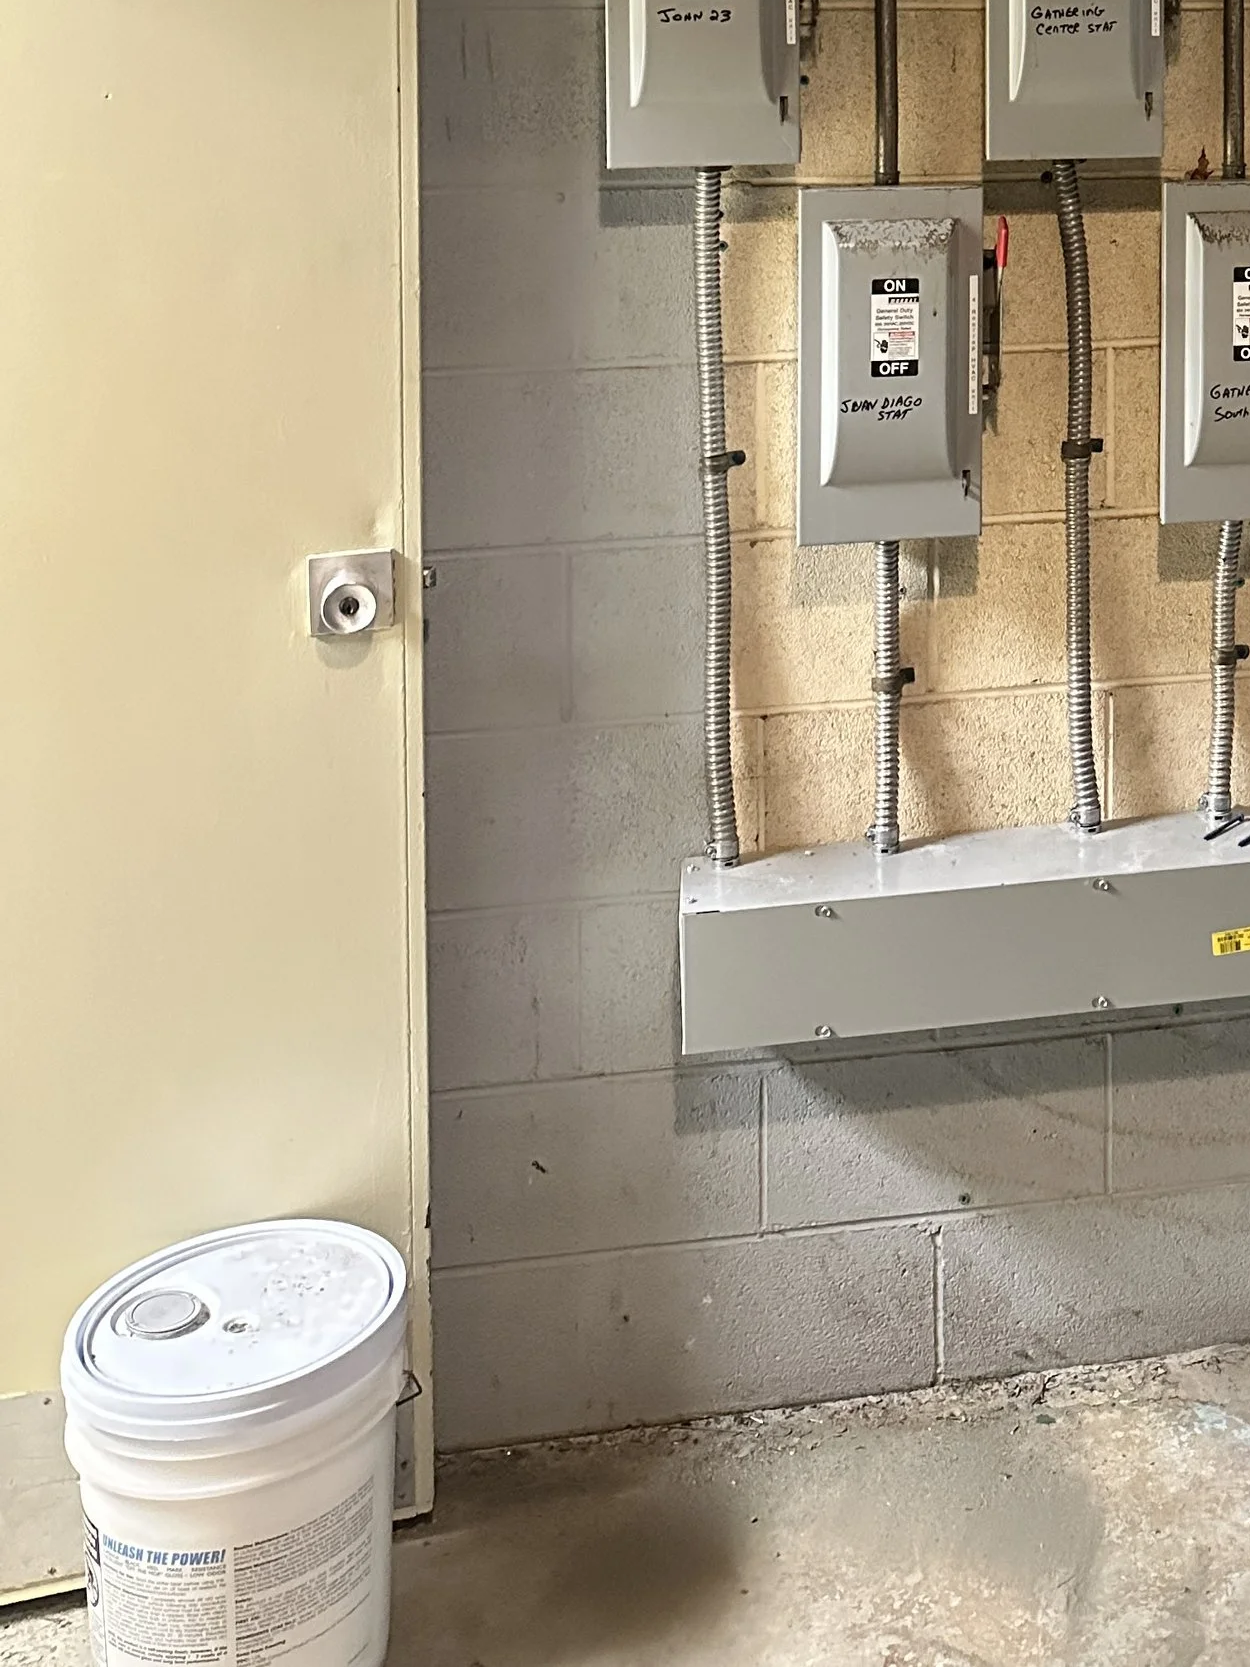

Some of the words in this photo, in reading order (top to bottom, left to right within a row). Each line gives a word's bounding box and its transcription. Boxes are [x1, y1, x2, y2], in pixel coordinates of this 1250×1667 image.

[657, 8, 703, 23] JOHN
[709, 9, 731, 22] 23
[884, 279, 907, 292] ON
[878, 362, 910, 375] OFF
[881, 396, 922, 409] DIAGO
[877, 408, 913, 421] STAT
[102, 1534, 144, 1562] UNLEASH
[146, 1550, 168, 1565] THE
[171, 1549, 226, 1565] POWER!
